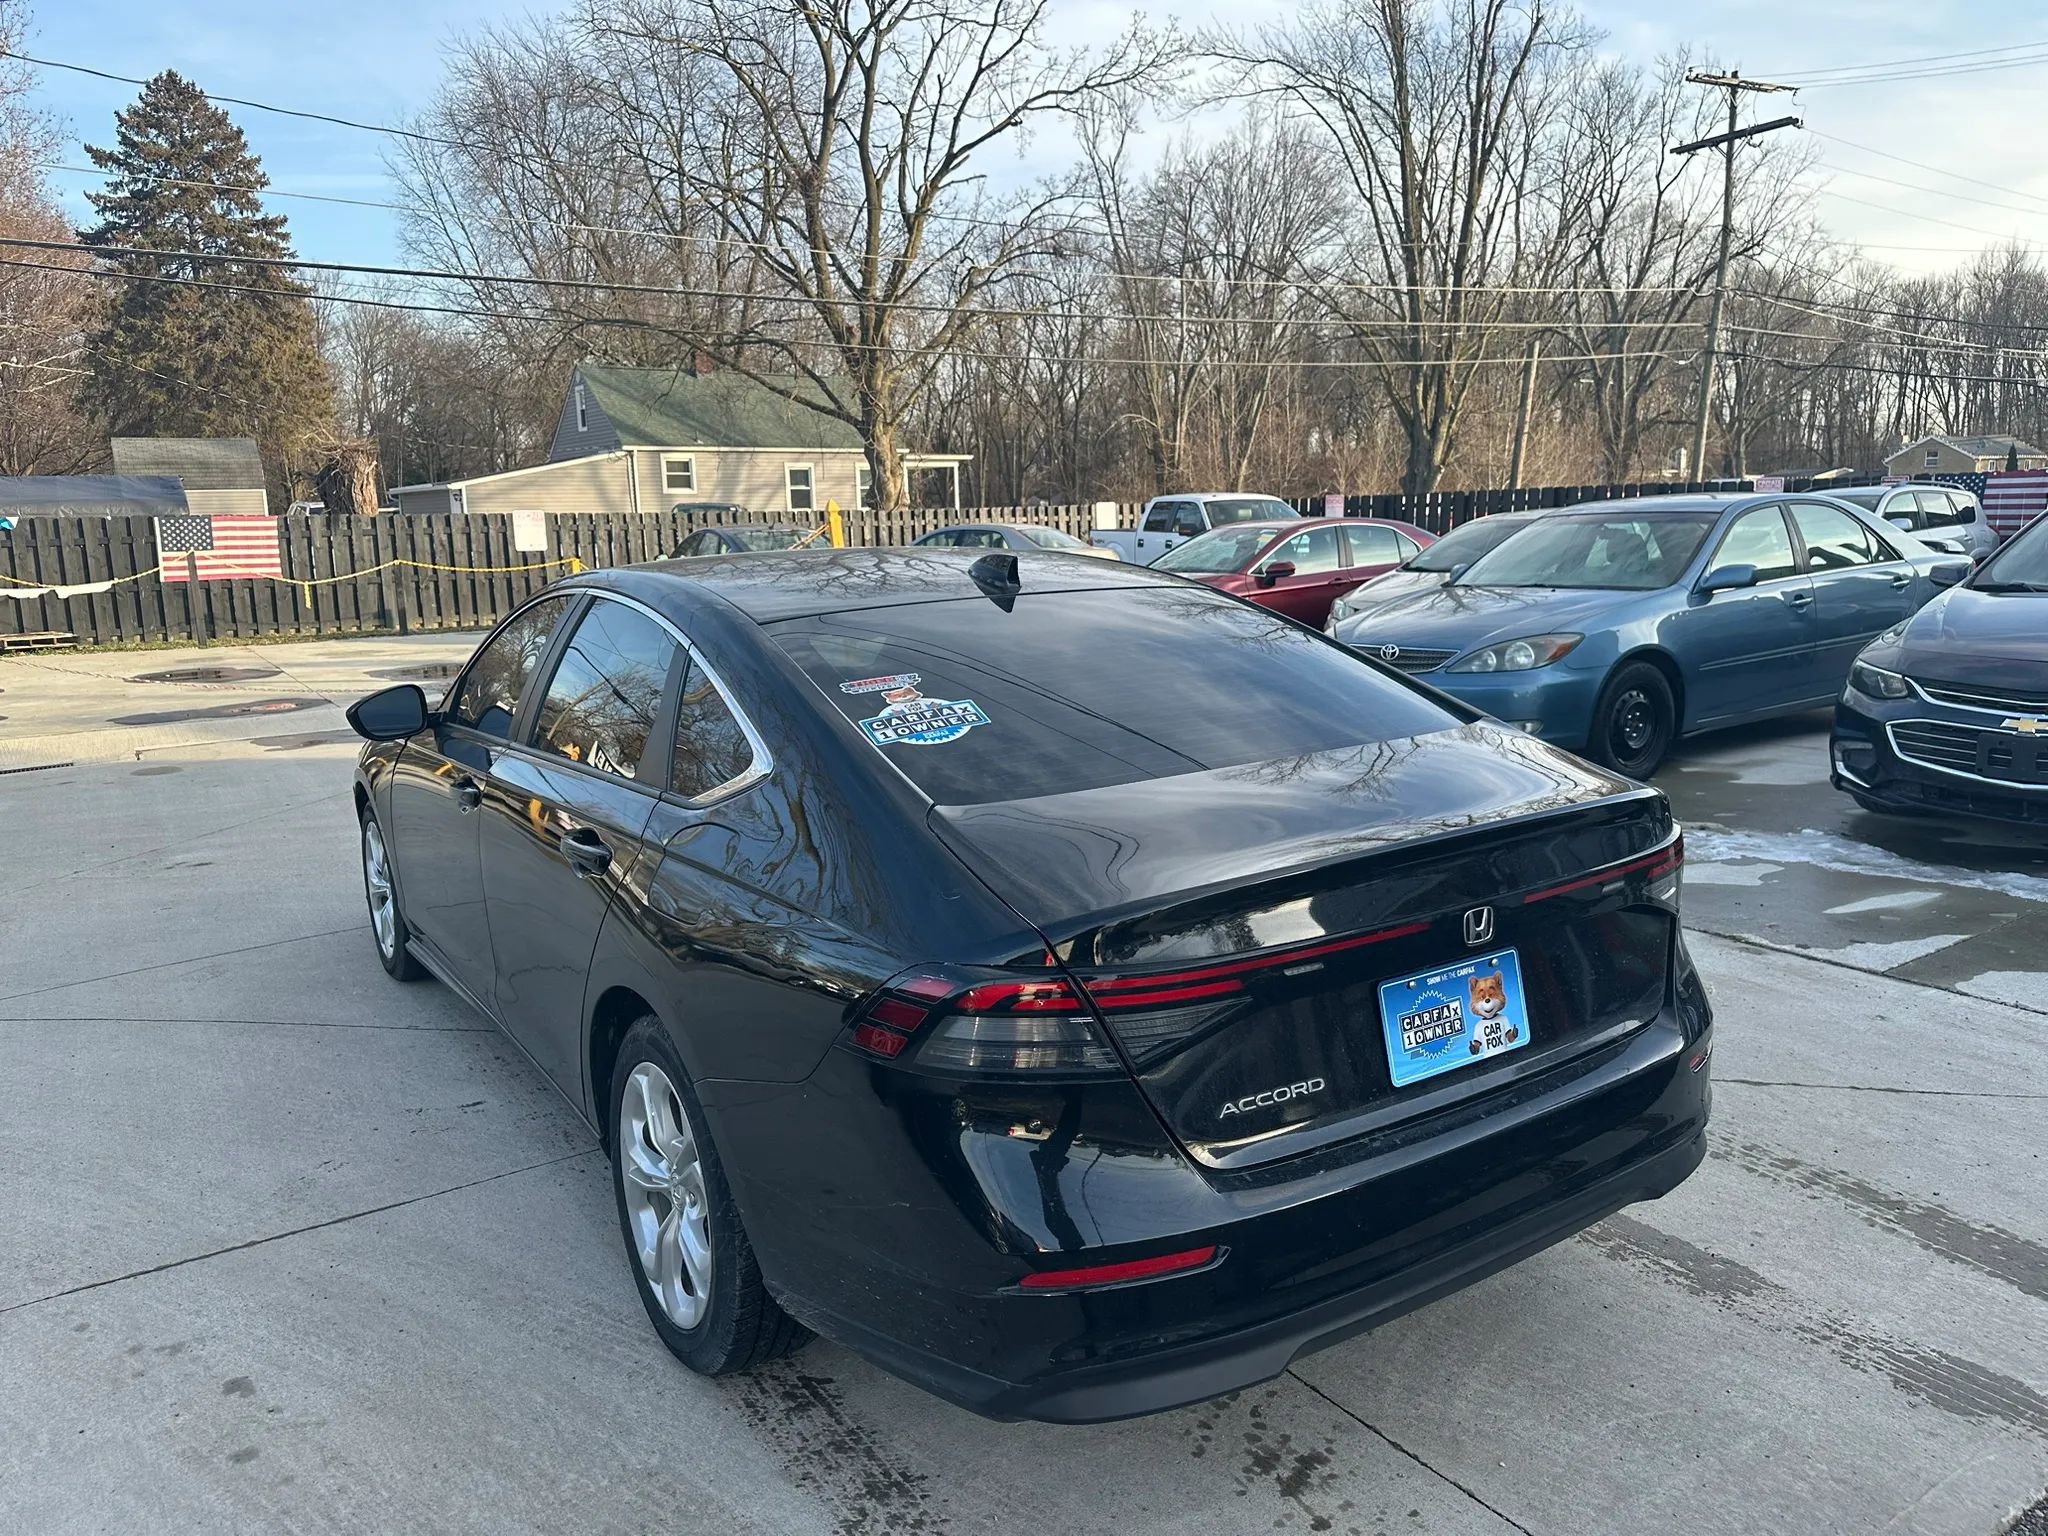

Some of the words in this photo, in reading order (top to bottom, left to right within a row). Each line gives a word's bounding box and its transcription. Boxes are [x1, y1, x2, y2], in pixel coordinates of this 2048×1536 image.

[871, 705, 973, 730] CARFAX
[1426, 976, 1441, 986] SHOW
[1456, 965, 1475, 977] CARFAX
[1402, 1005, 1461, 1031] CARFAX
[1483, 1022, 1502, 1037] CAR
[1486, 1036, 1504, 1050] FOX
[1219, 1078, 1326, 1119] ACCORD
